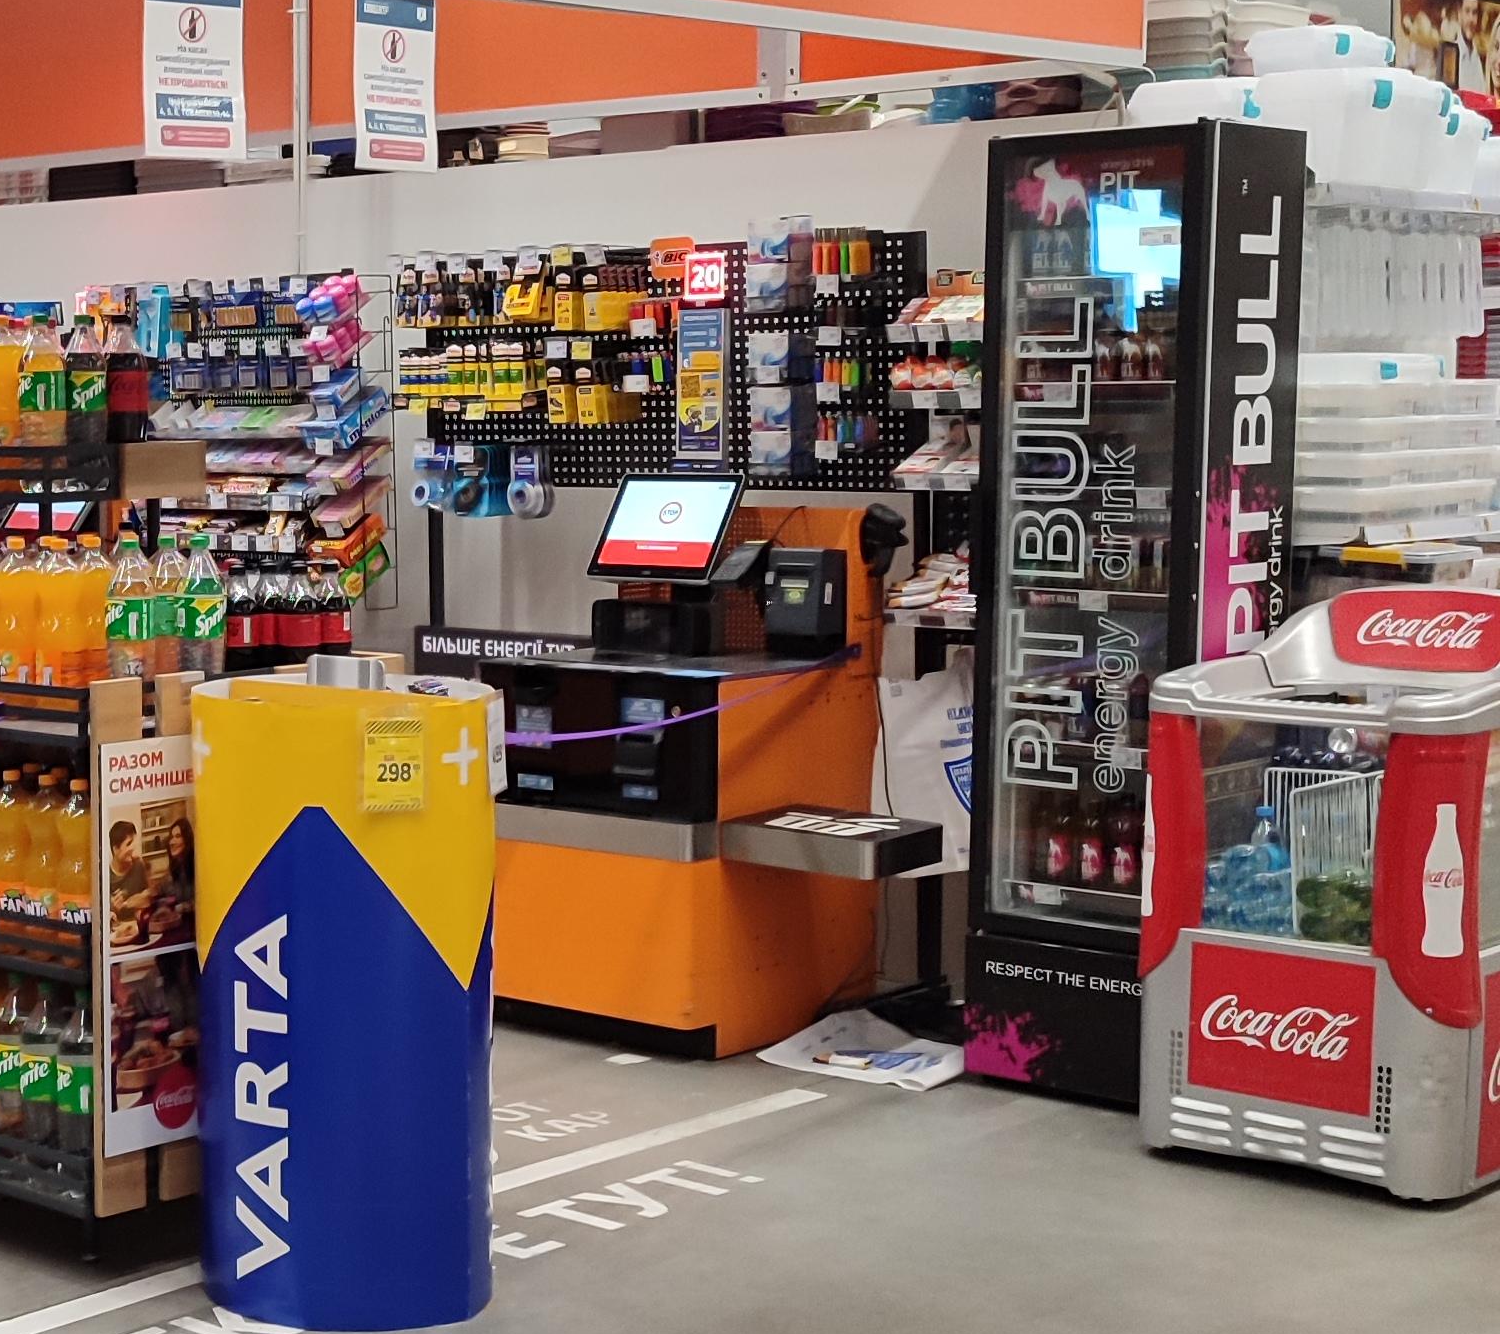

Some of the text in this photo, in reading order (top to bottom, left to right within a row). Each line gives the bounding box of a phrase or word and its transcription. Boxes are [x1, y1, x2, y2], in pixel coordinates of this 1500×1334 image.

[1101, 171, 1141, 194] PIT
[690, 264, 720, 289] 20
[1010, 297, 1095, 581] BULL
[1226, 195, 1281, 654] PIT BULL
[1267, 505, 1284, 577] drink
[422, 635, 481, 655] БІЛЬШЕ
[1093, 444, 1140, 794] energy drink
[1356, 609, 1494, 650] Coca-Cola
[1003, 609, 1085, 791] PIT
[109, 751, 163, 772] РАЗОМ
[109, 768, 195, 793] СМАЧНІШЕ
[377, 762, 412, 782] 298
[985, 960, 1143, 997] RESPECT THE ENERG
[1199, 994, 1360, 1062] Coca-Cola
[235, 914, 290, 1278] VARTA
[516, 1160, 765, 1231] ТУТ!
